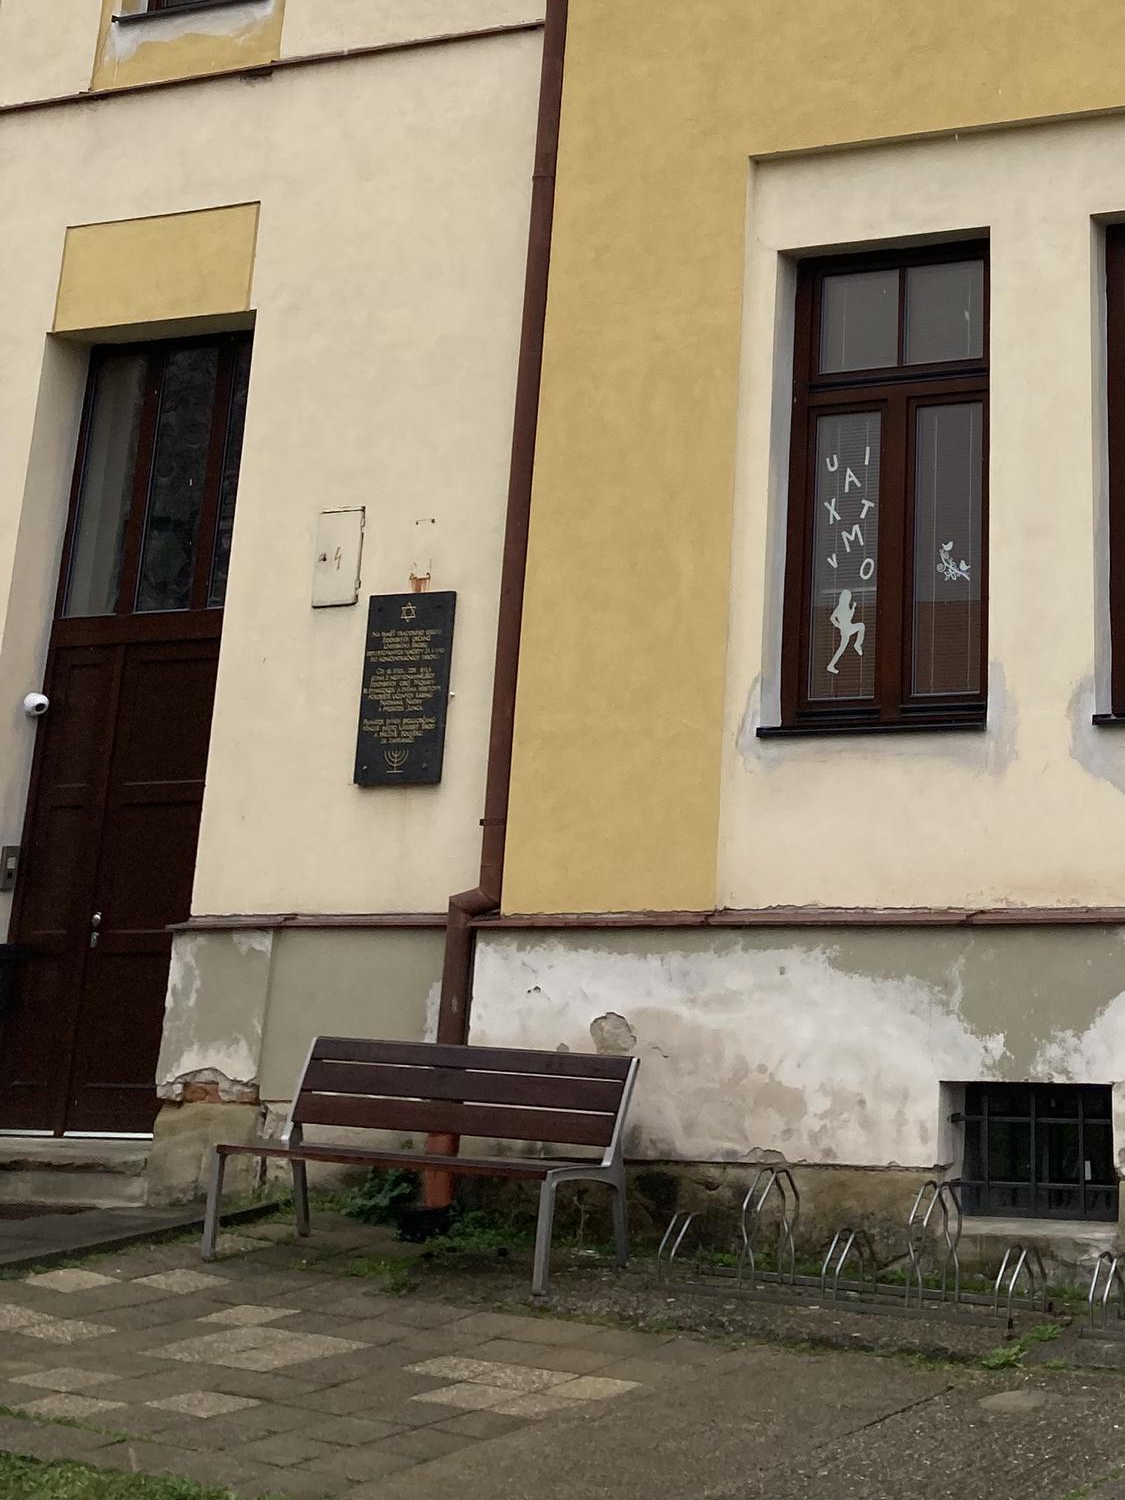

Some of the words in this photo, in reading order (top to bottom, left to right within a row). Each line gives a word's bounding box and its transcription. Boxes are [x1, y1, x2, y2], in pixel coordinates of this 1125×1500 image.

[826, 454, 839, 472] U
[844, 467, 862, 493] A
[823, 498, 841, 525] X
[859, 499, 875, 519] T
[841, 524, 865, 553] M
[859, 557, 875, 580] O
